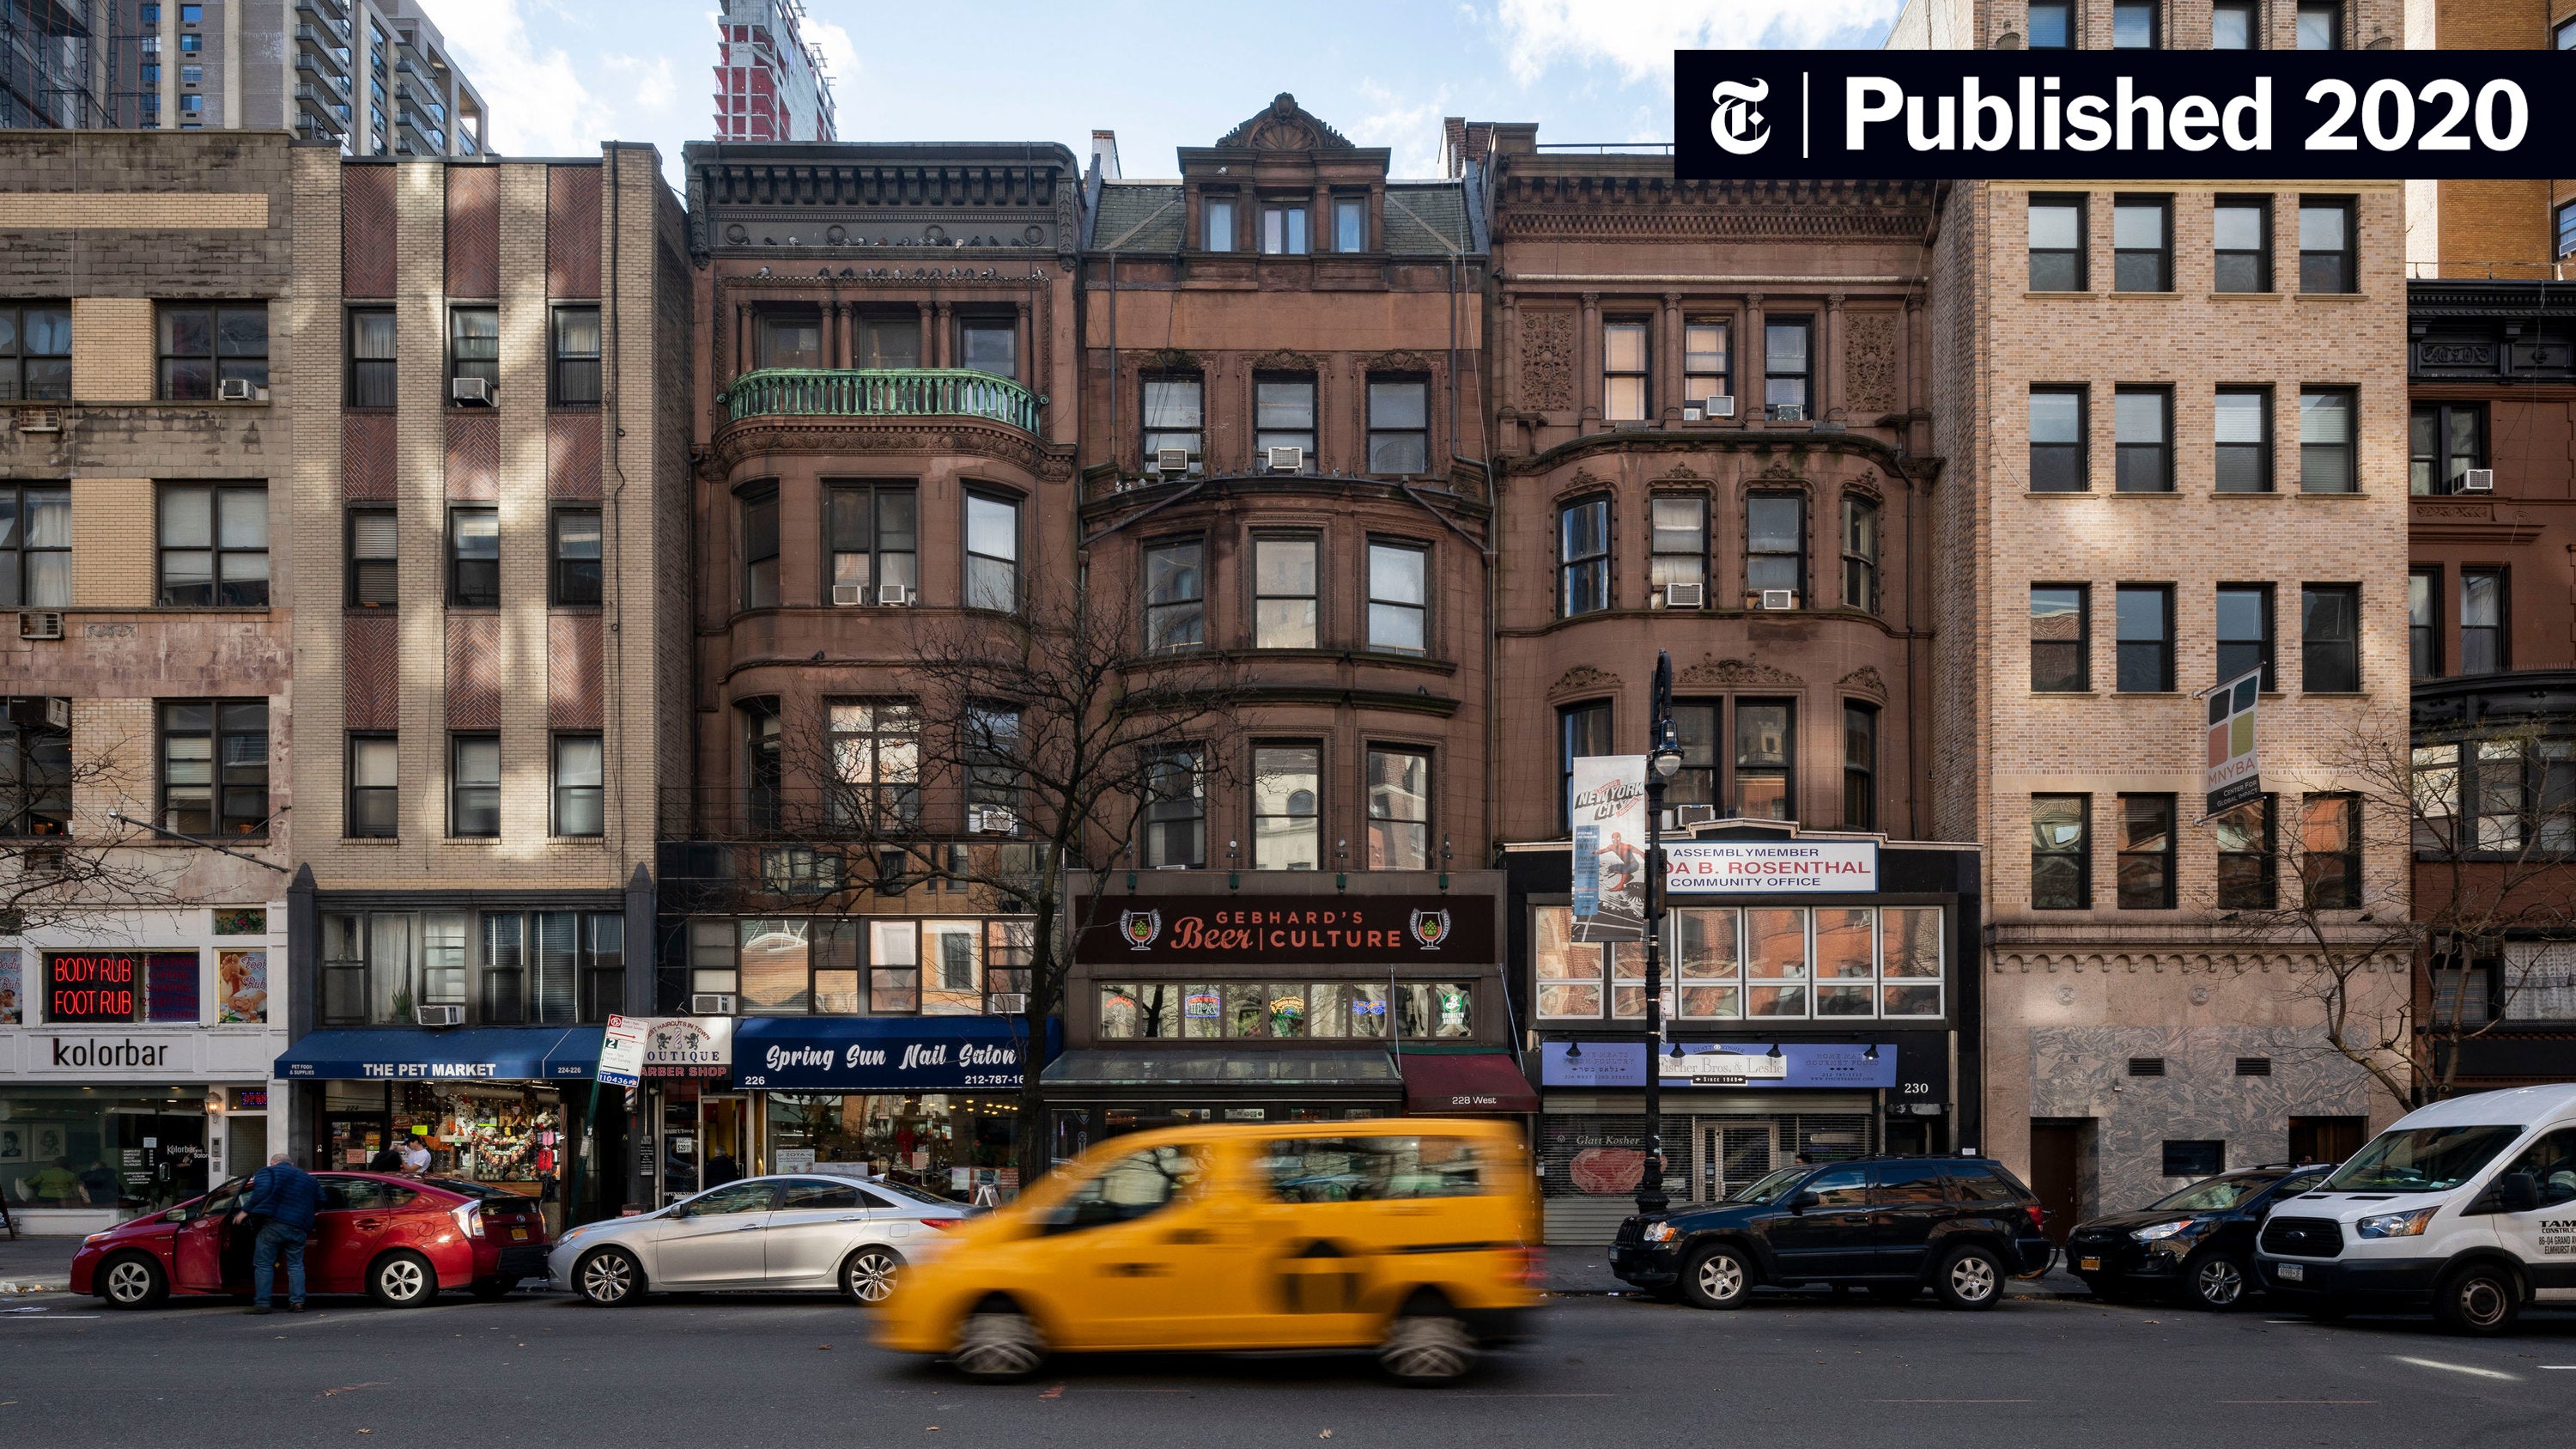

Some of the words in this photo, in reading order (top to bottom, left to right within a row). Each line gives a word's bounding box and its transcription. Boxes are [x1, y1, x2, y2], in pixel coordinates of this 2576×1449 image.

[2208, 757, 2256, 788] MNYBA
[2223, 784, 2245, 797] CENTER
[2244, 780, 2258, 789] FOR
[1575, 788, 1611, 809] NEW
[1607, 782, 1644, 802] YORK
[2216, 795, 2238, 807] GLOBAL
[2238, 788, 2258, 799] IMPACT
[1595, 798, 1629, 821] CITY
[1674, 848, 1819, 857] ASSEMBLYMEMBER
[1698, 862, 1719, 874] B.
[1728, 861, 1871, 874] ROSENTHAL
[1670, 878, 1763, 886] COMMUNITY
[1766, 877, 1821, 886] OFFICE
[1216, 911, 1364, 924] GEBHARD'S
[1170, 916, 1255, 950] Beer
[1270, 930, 1401, 947] CULTURE
[54, 958, 97, 983] BODY
[100, 958, 131, 983] RUB
[54, 989, 96, 1015] FOOT
[100, 989, 132, 1015] RUB
[1189, 1002, 1217, 1014] IPA
[657, 1020, 687, 1031] HAIRCUTS
[694, 1026, 712, 1041] TOWN
[53, 1038, 168, 1067] kolorbar
[1693, 1044, 1713, 1053] GLATT
[1720, 1044, 1746, 1054] KOSHER
[647, 1050, 720, 1063] OUTIQUE
[766, 1044, 835, 1072] Spring
[846, 1044, 886, 1068] Sun
[898, 1044, 947, 1070] Nail
[958, 1044, 1017, 1068] Salon
[363, 1063, 393, 1076] THE
[398, 1063, 428, 1076] PET
[432, 1063, 496, 1076] MARKET
[640, 1067, 684, 1077] ARBER
[689, 1066, 727, 1077] SHOP
[1659, 1056, 1698, 1074] Fischer
[1733, 1061, 1743, 1073] &
[1746, 1056, 1783, 1074] Leslie
[598, 1073, 628, 1086] 110436
[744, 1075, 765, 1085] 226
[964, 1075, 1024, 1085] 212-787-16
[1904, 1082, 1929, 1094] 230
[1452, 1096, 1471, 1105] 228
[1473, 1096, 1497, 1105] West
[1577, 1135, 1603, 1146] Glatt
[1605, 1135, 1640, 1146] Kosher
[167, 1145, 197, 1155] Kolorbar
[2554, 1236, 2571, 1245] GRAND
[2544, 1245, 2570, 1255] ELMHURST
